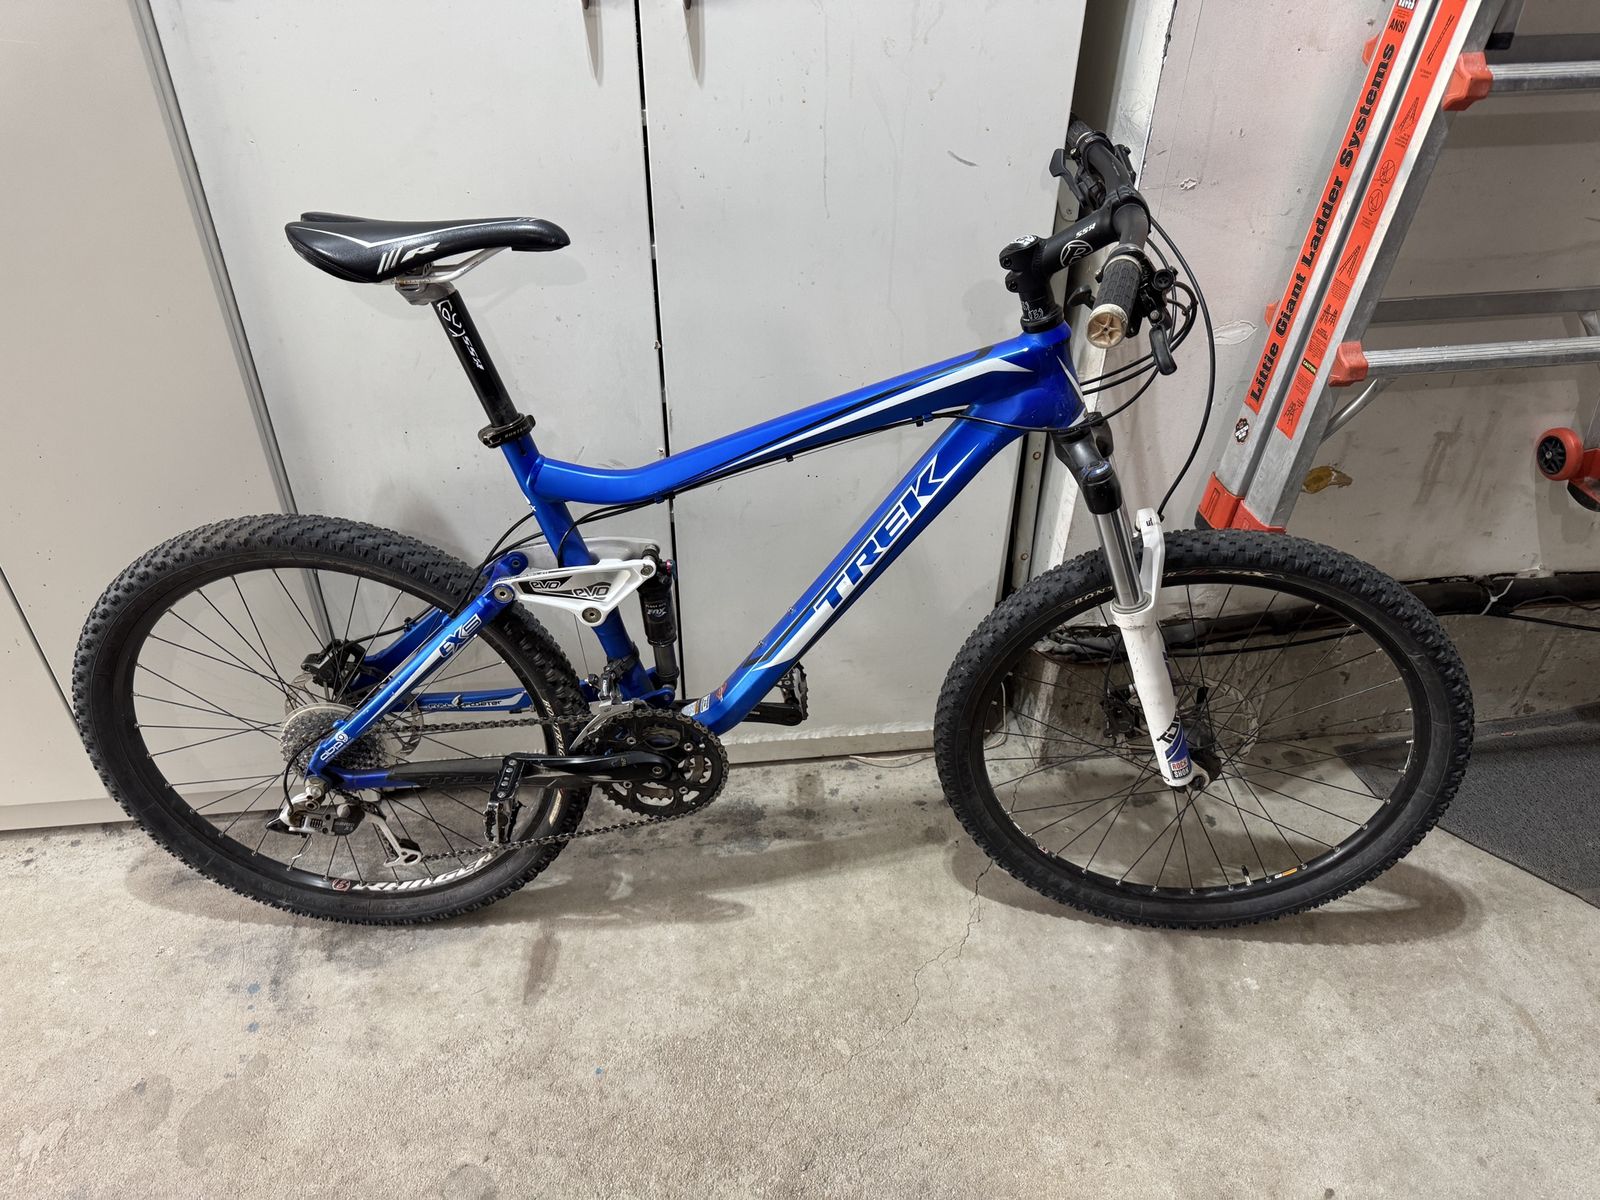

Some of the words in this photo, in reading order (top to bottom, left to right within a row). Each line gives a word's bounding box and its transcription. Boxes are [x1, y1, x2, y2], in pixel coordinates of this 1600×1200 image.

[1389, 18, 1407, 34] ANSI
[1250, 342, 1279, 403] Little
[1276, 272, 1306, 338] Giant
[1301, 176, 1343, 268] Ladder
[1340, 43, 1395, 168] Systems
[813, 453, 948, 612] TREK
